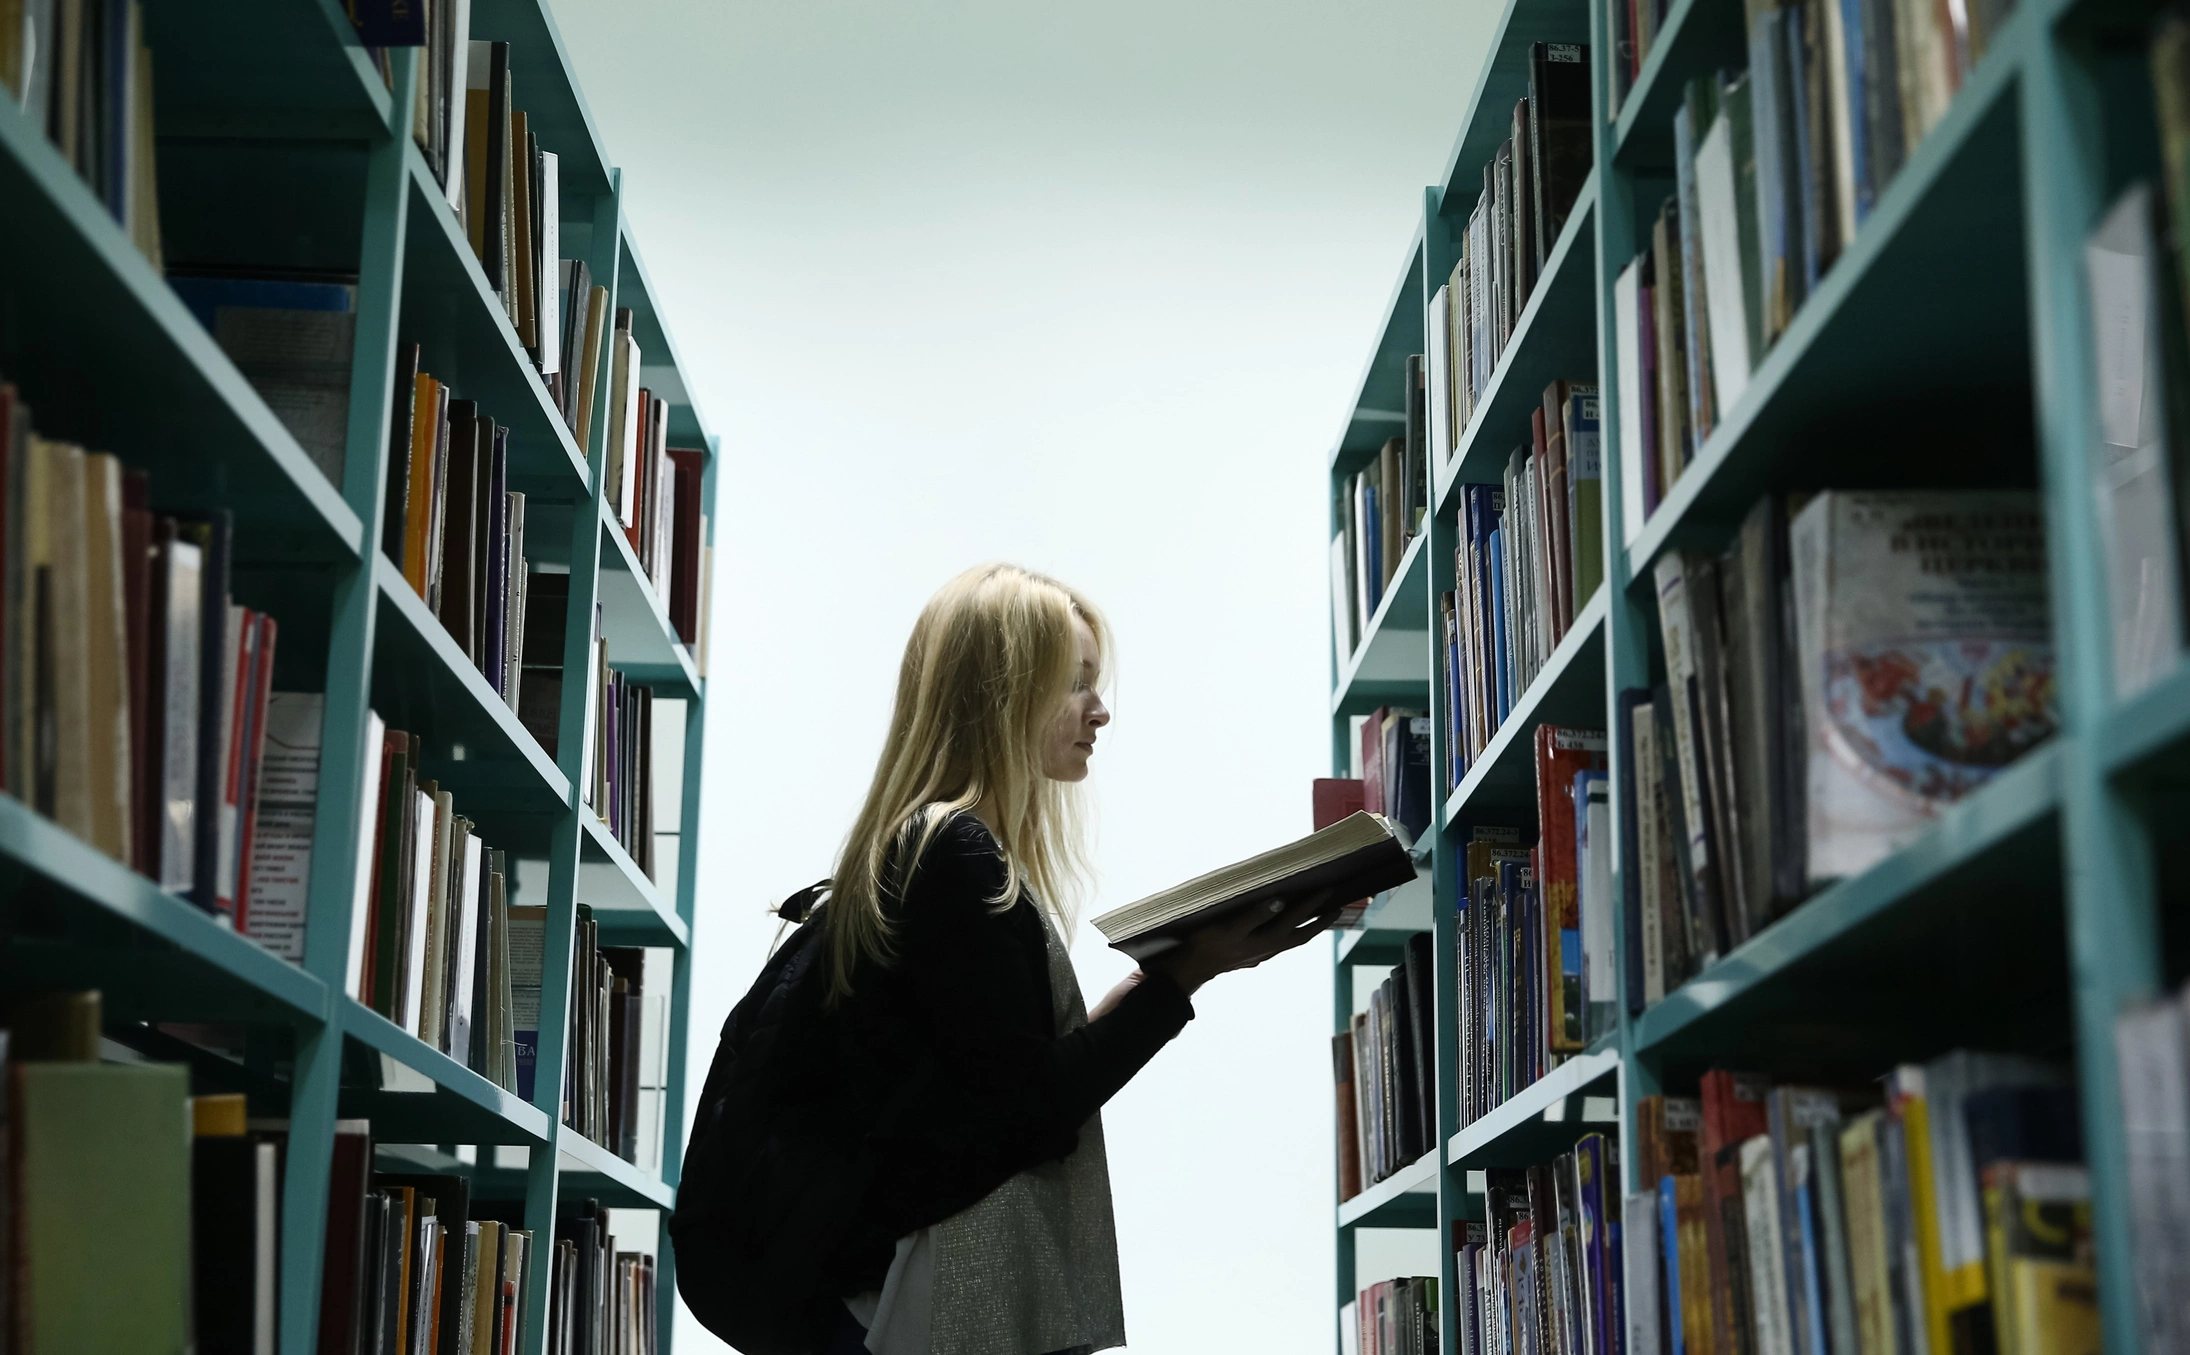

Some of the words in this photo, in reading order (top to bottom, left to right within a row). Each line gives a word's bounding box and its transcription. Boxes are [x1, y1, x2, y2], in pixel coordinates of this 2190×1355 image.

[1548, 44, 1580, 53] 86.37-5
[1475, 827, 1518, 836] 86.372.24-3
[1539, 1257, 1547, 1313] БОЛЬШАЯ
